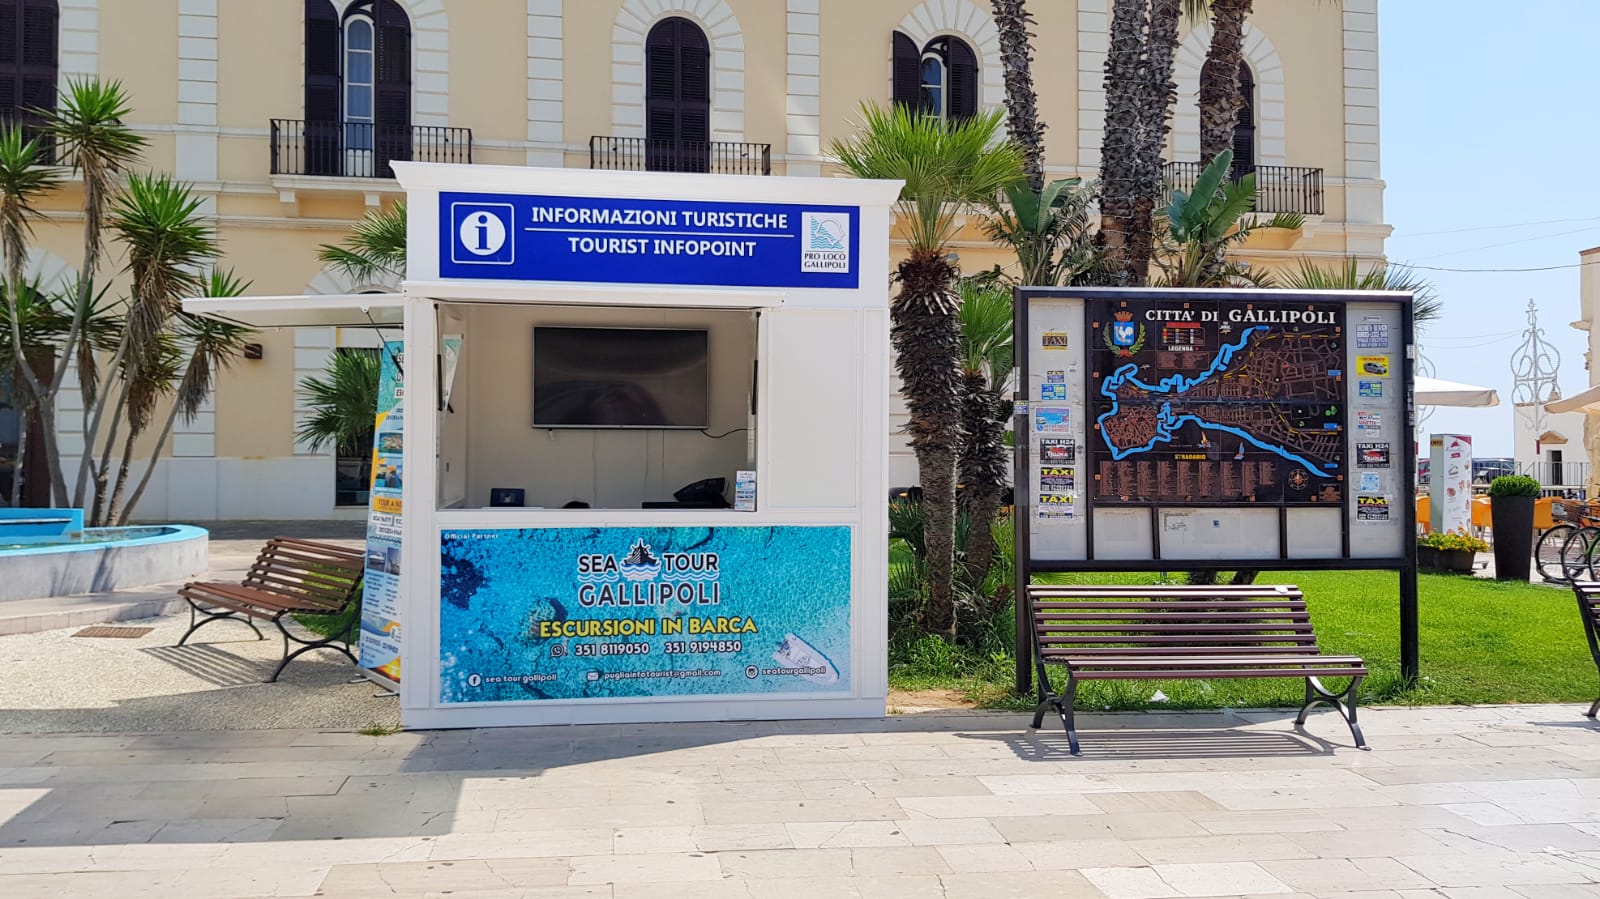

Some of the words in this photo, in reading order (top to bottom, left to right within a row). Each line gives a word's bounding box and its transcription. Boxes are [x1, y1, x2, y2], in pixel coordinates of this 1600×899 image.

[531, 207, 677, 228] INFORMAZIONI
[682, 211, 788, 230] TURISTICHE
[568, 237, 649, 255] TOURIST
[653, 238, 757, 257] INFOPOINT
[804, 251, 821, 260] PRO
[824, 252, 846, 261] LOCO
[804, 260, 846, 269] GALLIPOLI
[1145, 309, 1195, 322] CITTA'
[1201, 311, 1219, 322] DI
[1229, 309, 1337, 324] GALLIPOLI
[1041, 495, 1073, 503] TAXI
[578, 555, 618, 573] SEA
[663, 554, 719, 571] TOUR
[578, 582, 720, 607] GALLIPOLI
[538, 618, 655, 638] ESCURSIONI
[662, 617, 682, 635] IN
[689, 616, 757, 634] BARCA
[575, 644, 596, 656] 351
[600, 643, 649, 655] 8119050
[665, 642, 685, 654] 351
[689, 641, 742, 653] 9194850
[503, 675, 521, 683] tour
[522, 673, 557, 684] gallipoli
